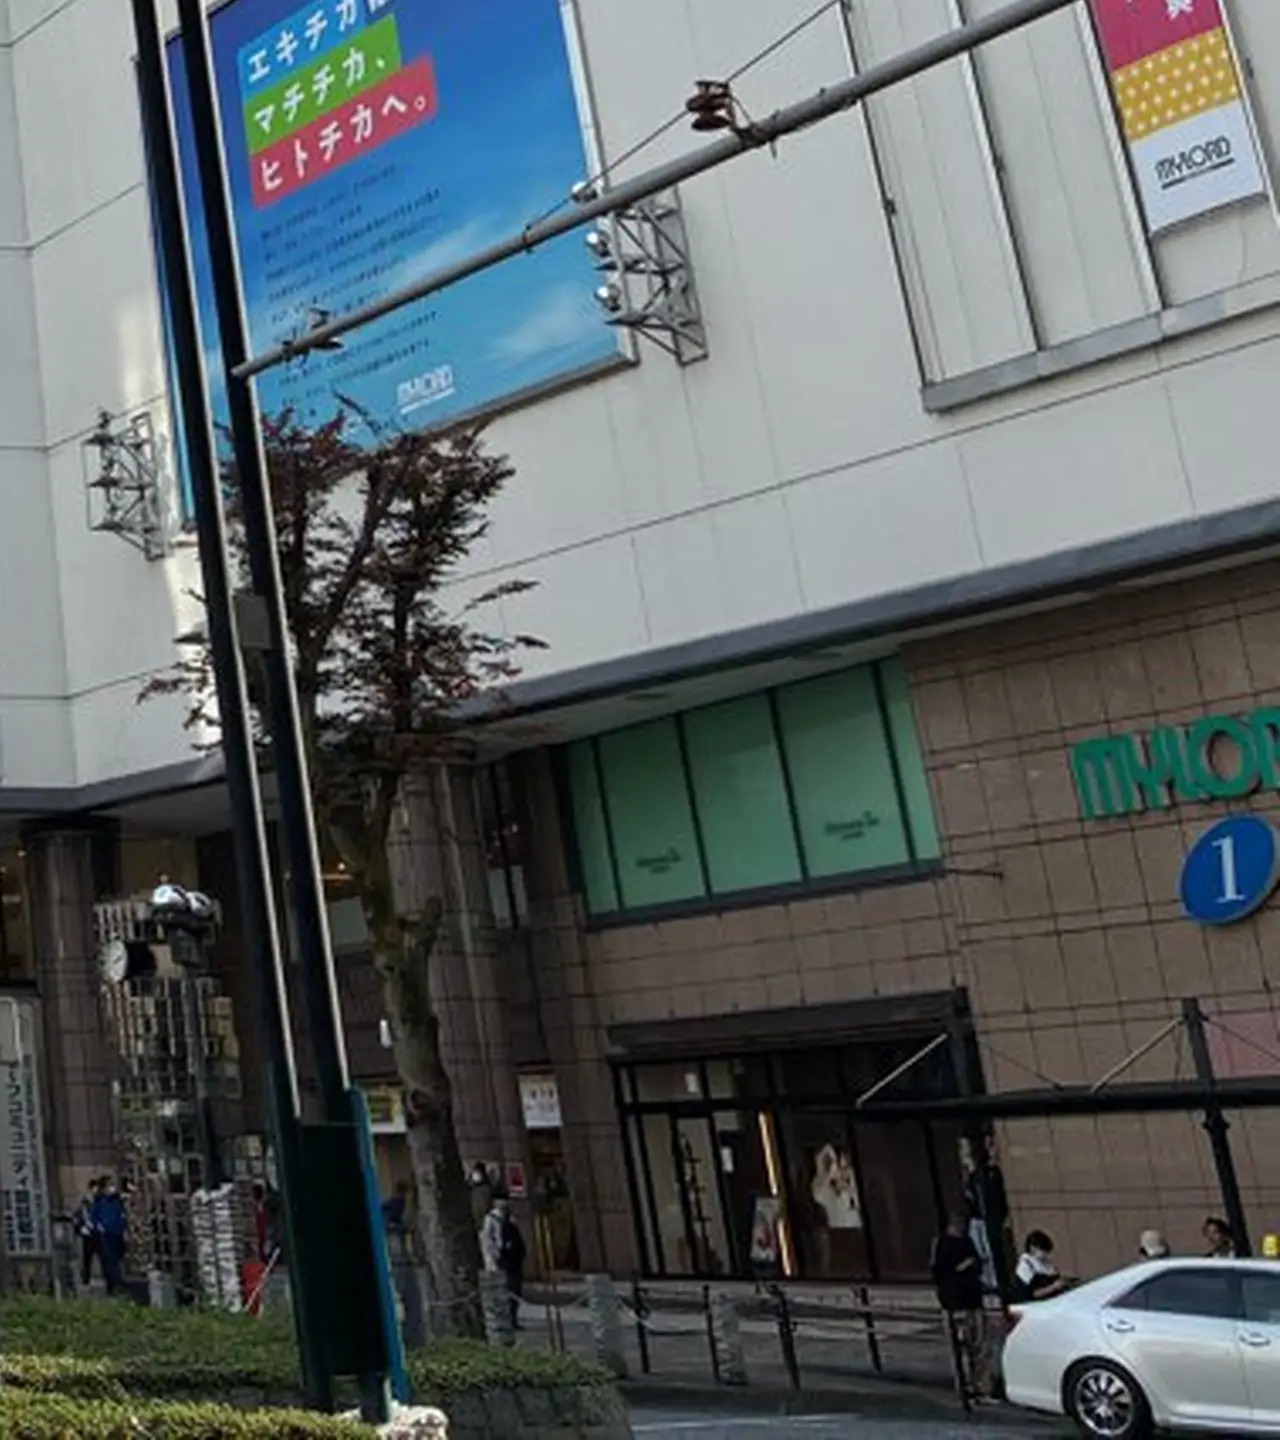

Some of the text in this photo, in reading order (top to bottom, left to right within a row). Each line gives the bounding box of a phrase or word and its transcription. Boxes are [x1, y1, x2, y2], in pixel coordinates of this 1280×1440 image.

[254, 47, 385, 135] マチチカ、
[261, 94, 427, 192] ヒトチカへ。
[1211, 835, 1247, 904] 1
